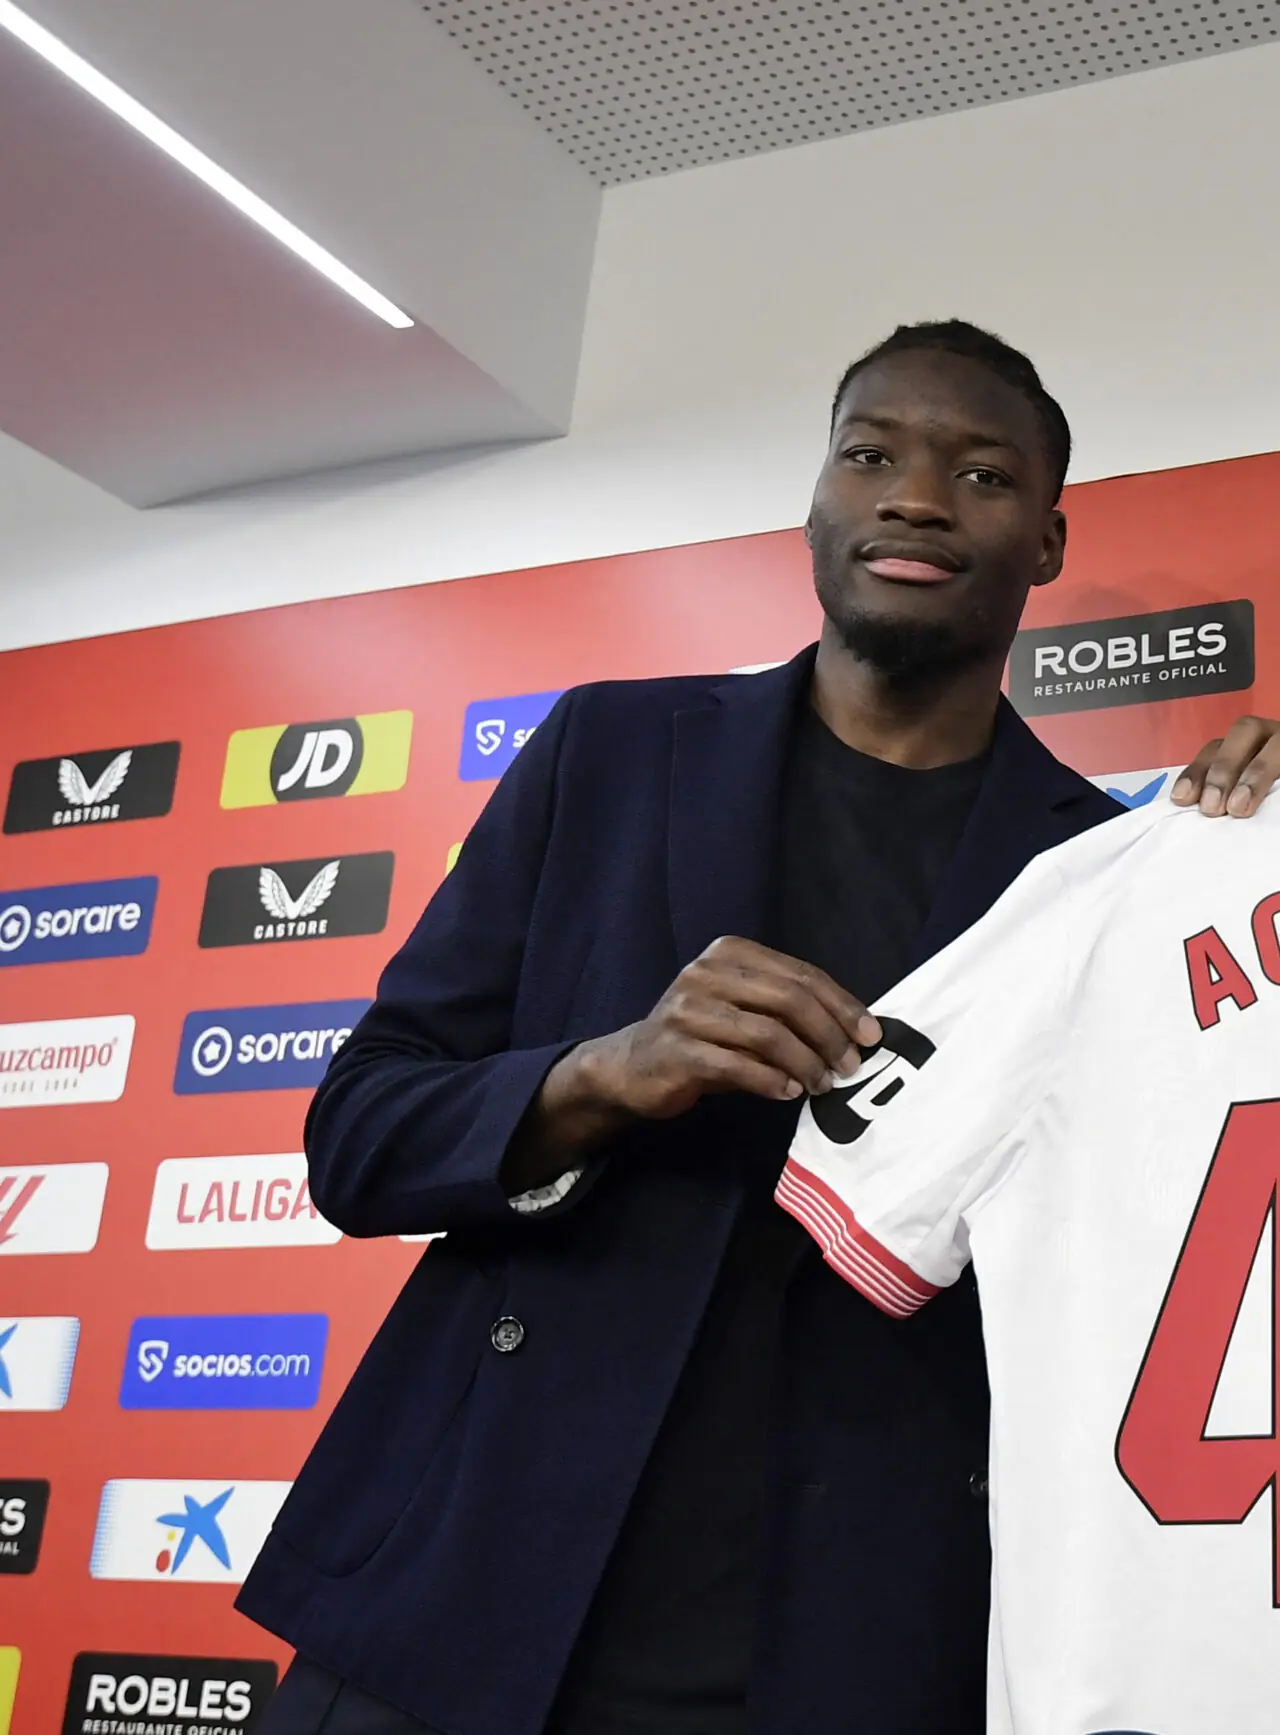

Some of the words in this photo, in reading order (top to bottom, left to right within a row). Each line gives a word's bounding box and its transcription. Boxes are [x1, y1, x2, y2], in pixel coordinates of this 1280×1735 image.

[1034, 622, 1227, 679] ROBLES
[1034, 672, 1151, 697] RESTAURANTE
[1158, 662, 1227, 681] OFICIAL
[276, 729, 353, 792] JD
[52, 803, 120, 826] CASTORE
[33, 902, 141, 939] sorare
[253, 919, 328, 940] CASTORE
[0, 1042, 113, 1074] uzcampo
[177, 1177, 318, 1224] LALIGA
[173, 1354, 310, 1378] socios.com
[86, 1674, 251, 1721] ROBLES
